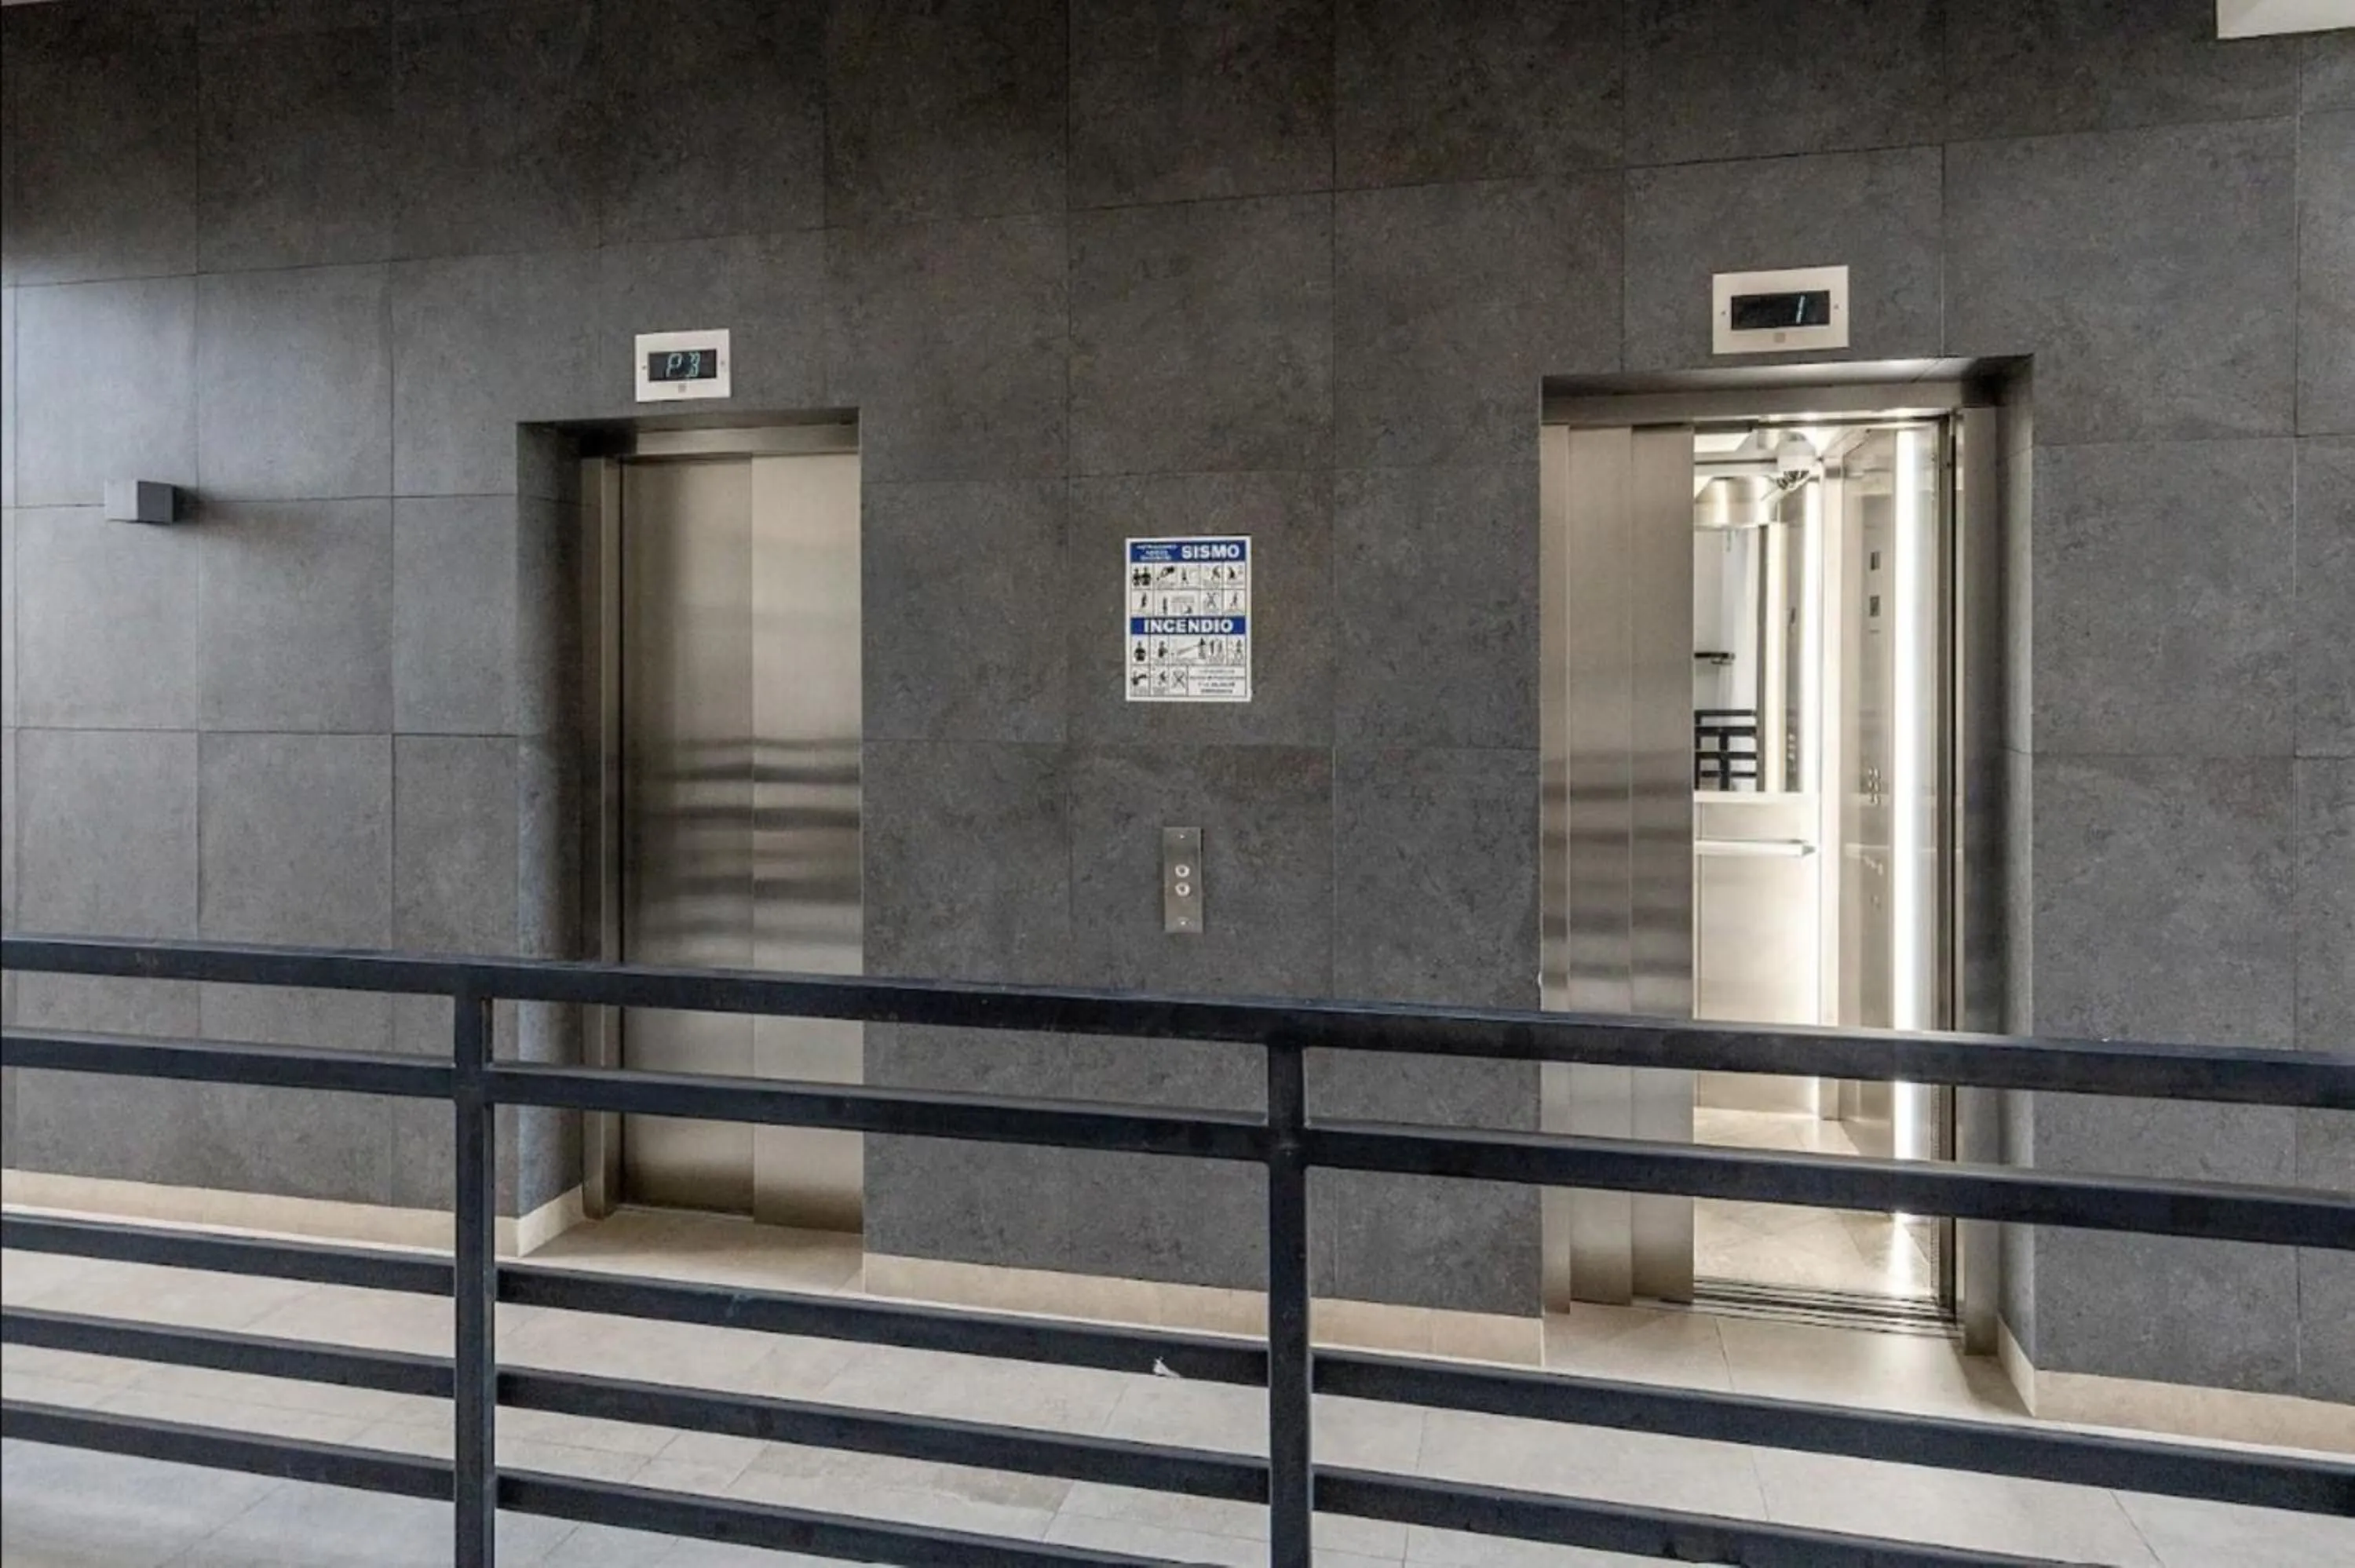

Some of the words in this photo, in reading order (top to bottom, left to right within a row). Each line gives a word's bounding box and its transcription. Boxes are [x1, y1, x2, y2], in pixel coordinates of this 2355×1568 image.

[1795, 295, 1806, 324] 1
[666, 352, 701, 377] P3
[1181, 544, 1240, 560] SISMO
[1143, 619, 1234, 633] INCENDIO
